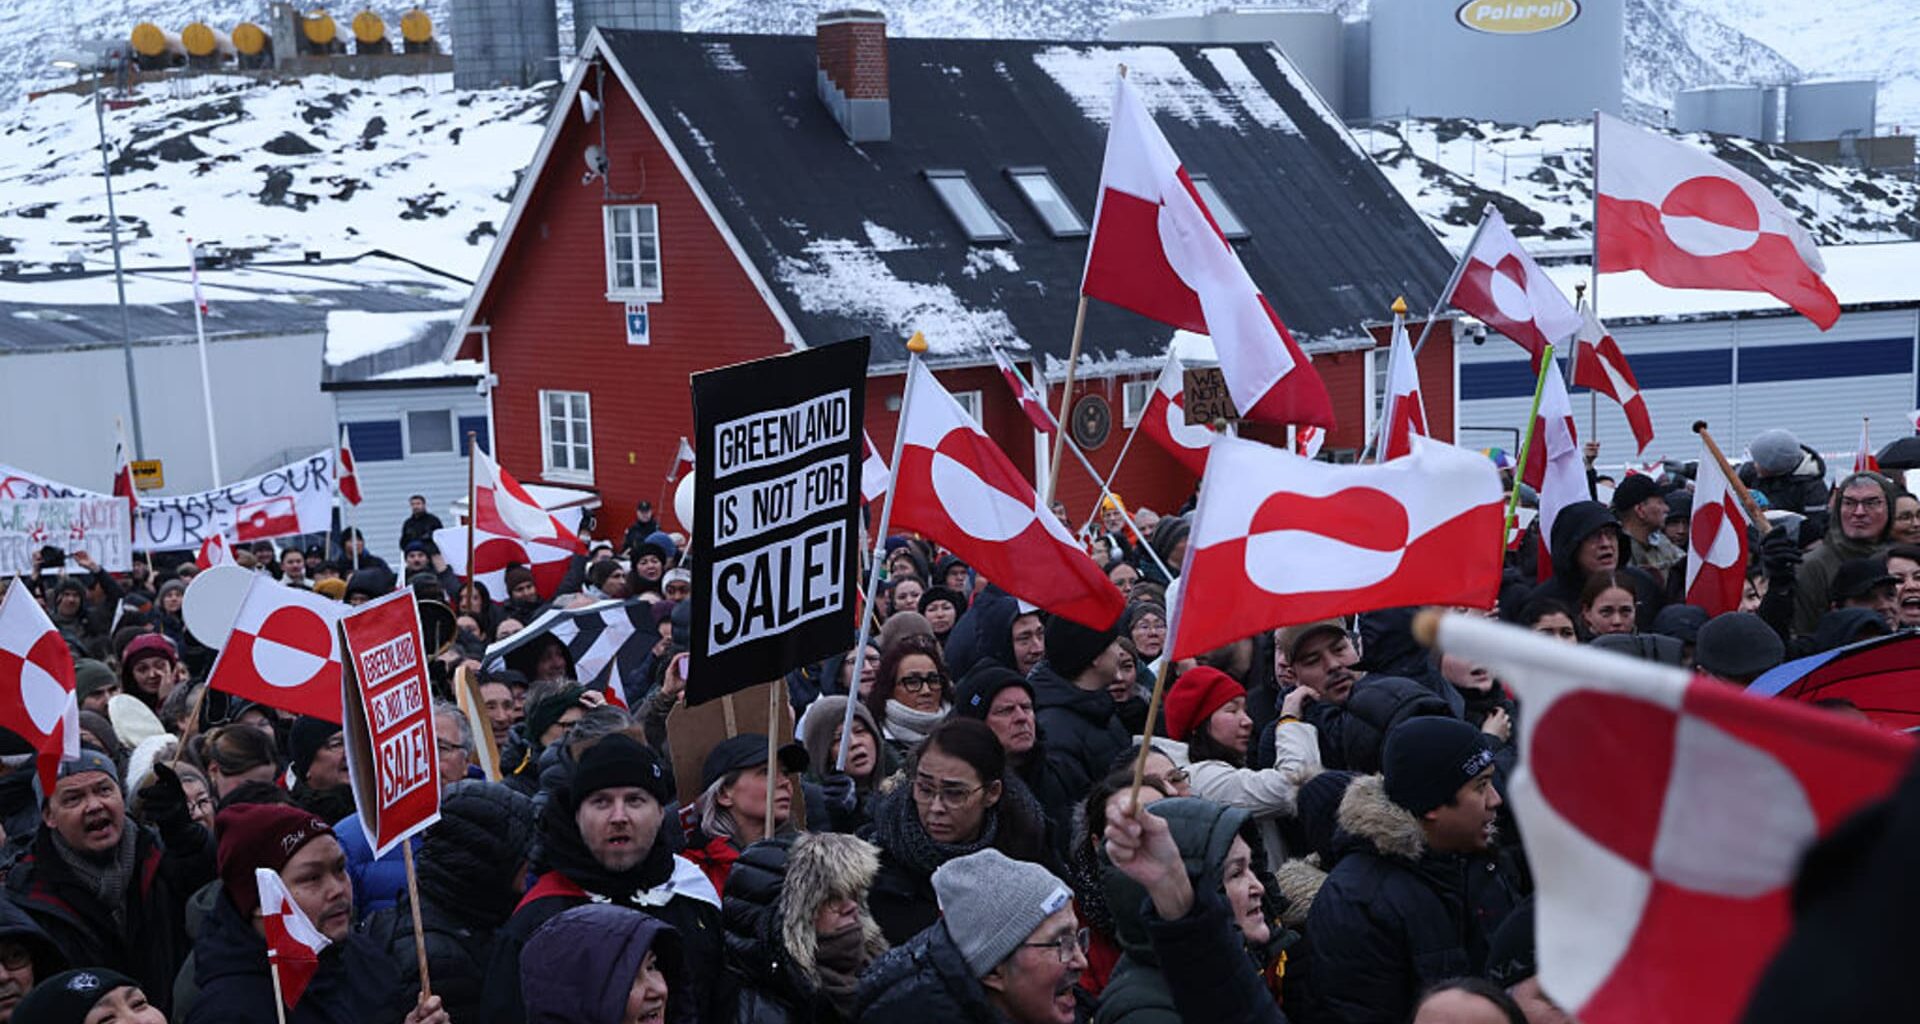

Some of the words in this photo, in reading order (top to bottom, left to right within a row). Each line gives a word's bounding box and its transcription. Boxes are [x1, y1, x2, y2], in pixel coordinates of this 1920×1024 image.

[719, 396, 847, 471] GREENLAND
[1191, 401, 1234, 423] SAL
[258, 456, 329, 498] OUR
[718, 494, 738, 540] IS
[752, 478, 797, 531] NOT
[805, 462, 844, 511] FOR
[79, 499, 120, 530] NOT
[713, 525, 843, 648] SALE!
[364, 636, 416, 682] GREENLAND
[374, 699, 386, 729] IS
[384, 689, 404, 723] NOT
[404, 680, 421, 712] FOR
[383, 726, 429, 804] SALE!
